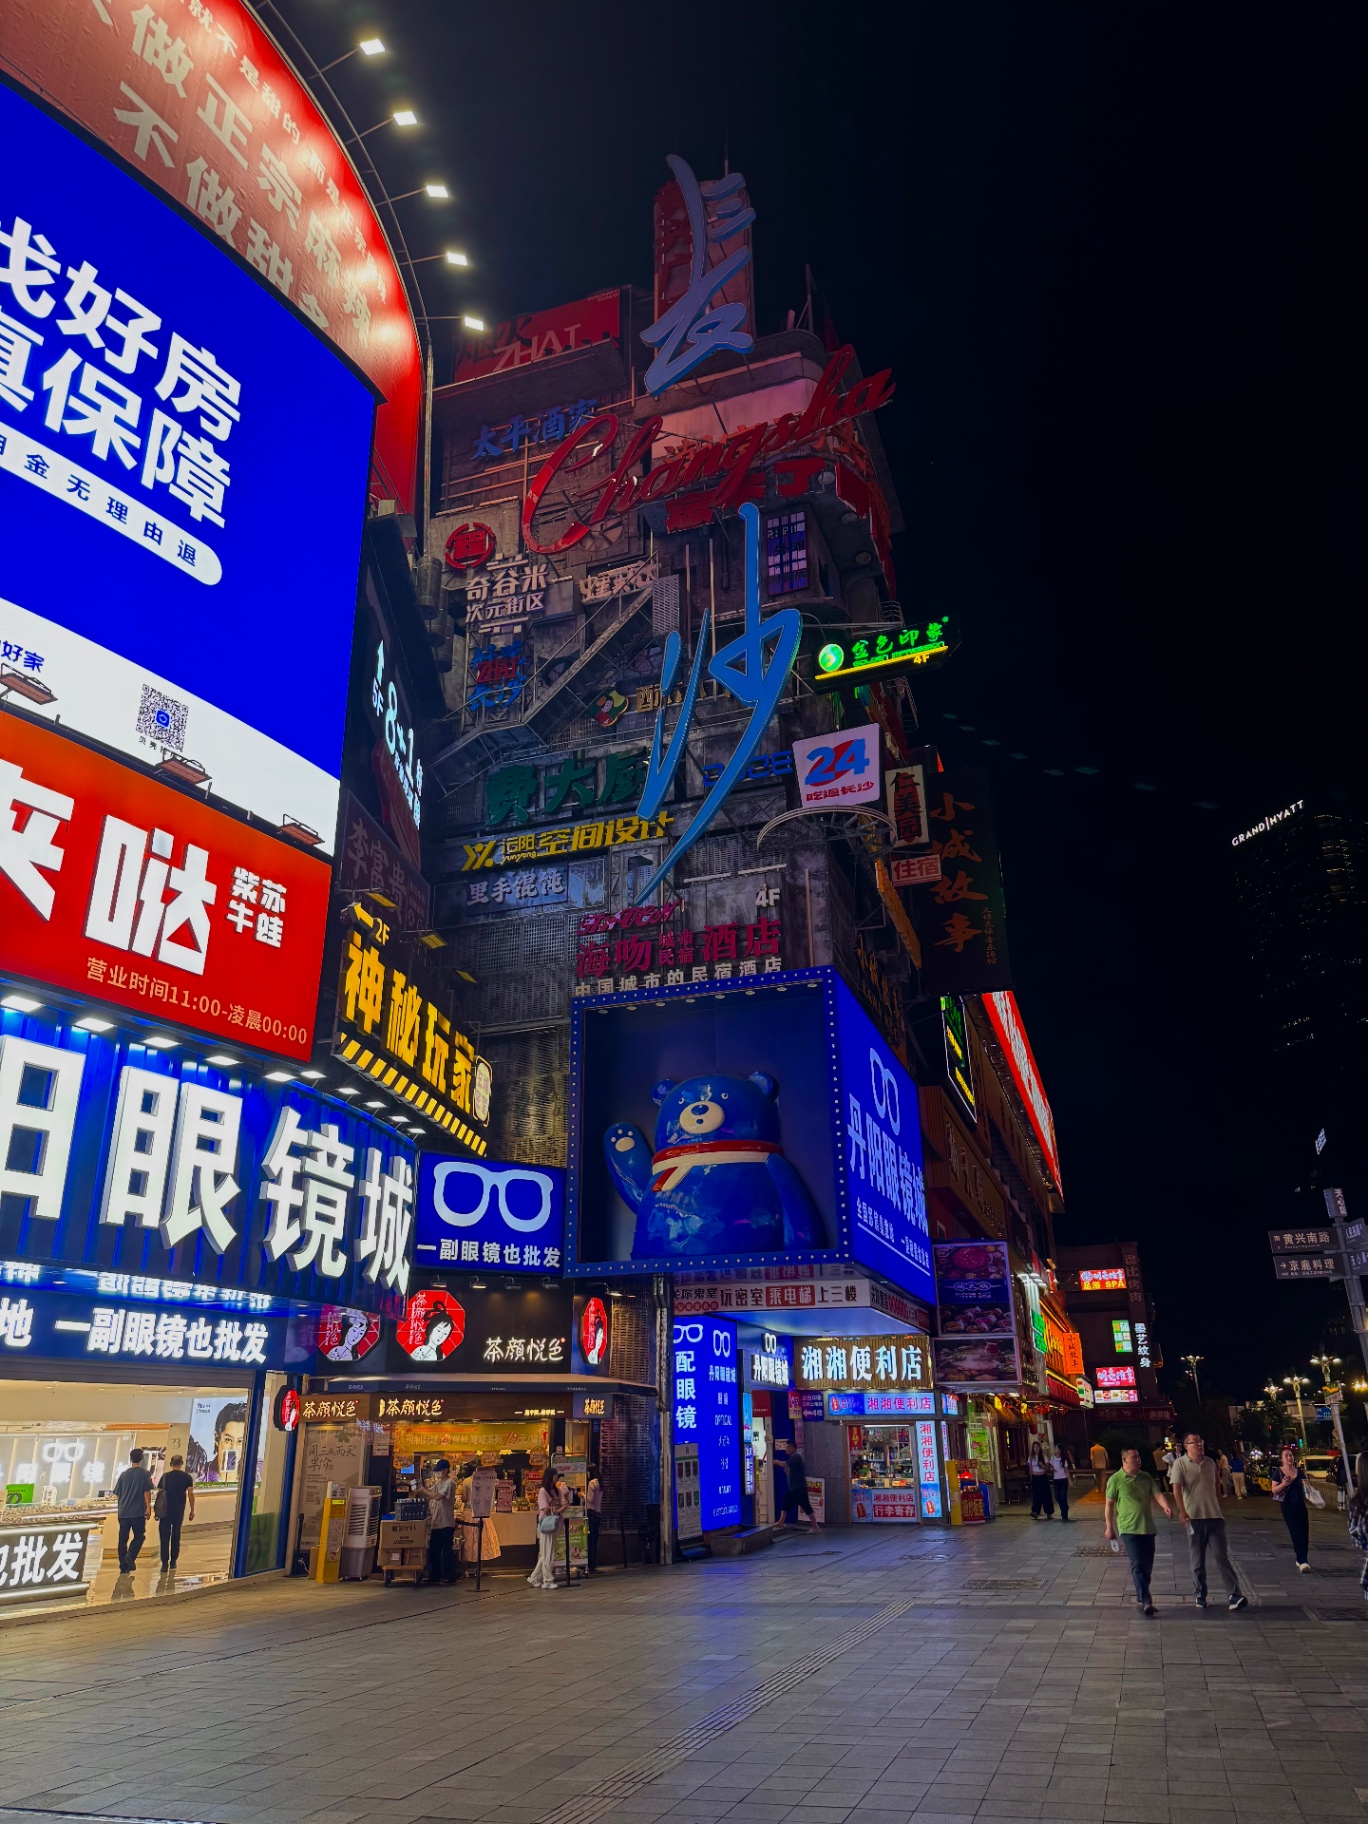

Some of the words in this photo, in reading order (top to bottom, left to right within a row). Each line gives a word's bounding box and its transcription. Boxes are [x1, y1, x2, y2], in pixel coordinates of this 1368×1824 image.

[521, 343, 896, 554] Changsha
[0, 433, 199, 567] 金无理由退
[465, 562, 549, 601] 奇谷米
[465, 591, 545, 623] 次元街区
[852, 622, 943, 660] 金色印象
[637, 501, 804, 909] 沙
[805, 738, 870, 786] 24
[1231, 822, 1266, 847] GRAND
[1269, 800, 1304, 827] HYATT
[467, 867, 565, 906] 里手馄饨
[893, 858, 939, 880] 住宿
[232, 866, 287, 914] 紫苏
[754, 886, 781, 907] 4F
[226, 899, 284, 949] 牛蛙
[374, 917, 391, 945] 2F
[700, 916, 783, 962] 酒店
[342, 934, 477, 1115] 神秘玩家
[417, 1238, 561, 1268] 一副眼镜也批发
[1282, 1231, 1330, 1246] 黄兴南路
[720, 1287, 764, 1308] 玩密室
[769, 1286, 812, 1306] 乘电梯
[817, 1284, 858, 1304] 上三楼
[1105, 1279, 1126, 1289] SPA
[55, 1307, 270, 1365] 一副眼镜也批发
[484, 1336, 565, 1363] 茶颜悦色
[1134, 1322, 1152, 1369] 墨艺纹身
[801, 1345, 923, 1381] 湘湘便利店
[387, 1398, 443, 1417] 茶颜悦色
[675, 1350, 697, 1429] 配眼镜
[867, 1396, 932, 1410] 湘湘便利店
[302, 1401, 357, 1419] 茶颜悦色
[919, 1423, 935, 1483] 湘湘便利店
[874, 1505, 916, 1516] 行李寄存
